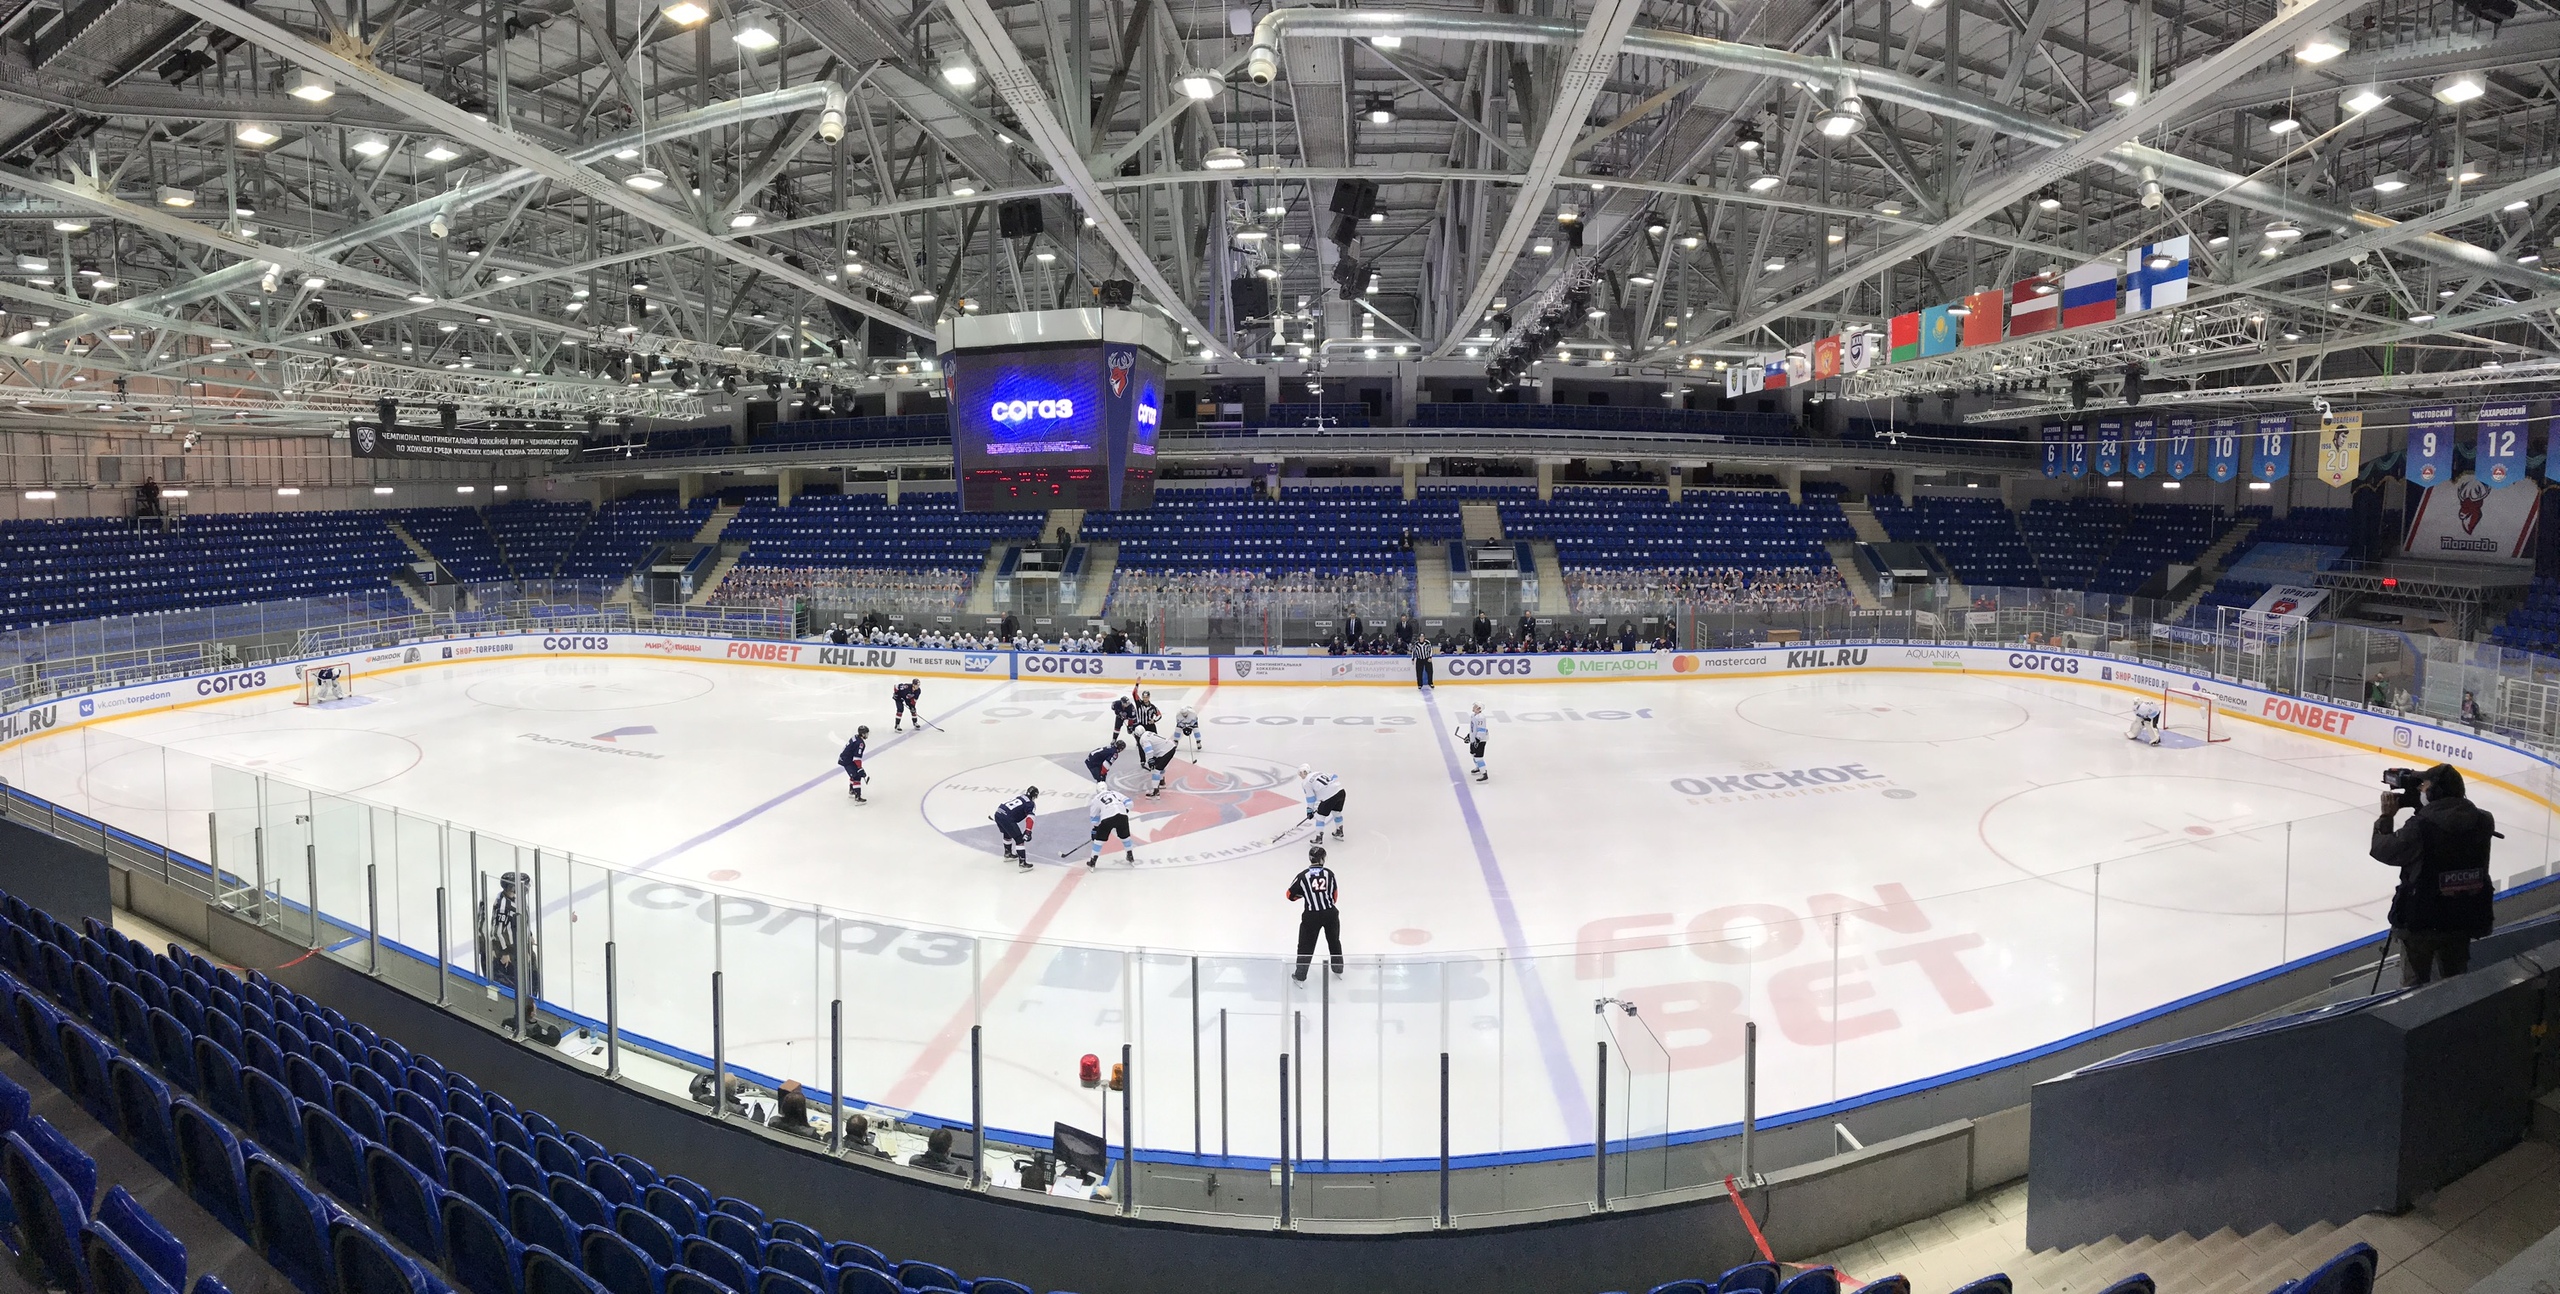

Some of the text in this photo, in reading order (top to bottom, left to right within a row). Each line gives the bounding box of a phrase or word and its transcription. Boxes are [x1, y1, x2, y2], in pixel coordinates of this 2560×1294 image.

[991, 398, 1074, 422] согаз
[2411, 407, 2453, 419] ЧИСТОВСКИЙ
[2480, 405, 2527, 417] САХАРОВСКИЙ
[2331, 416, 2359, 424] ОВАЛЕНКО
[381, 432, 421, 442] ЧЕМПИОНАТ
[421, 434, 479, 445] КОНТИНЕНТАЛЬНОЙ
[2101, 439, 2117, 456] 24
[2137, 436, 2146, 455] 4
[2173, 436, 2189, 455] 17
[2215, 437, 2233, 457] 10
[2262, 435, 2281, 456] 18
[2422, 433, 2437, 457] 9
[2488, 430, 2516, 457] 12
[396, 444, 405, 452] ПО
[2047, 444, 2055, 462] 6
[2071, 443, 2083, 462] 12
[2326, 449, 2348, 471] 20
[2280, 587, 2319, 598] ТОРПЕДО
[543, 637, 609, 651] согаз
[645, 642, 701, 652] МИР ПИЦЦЫ
[726, 642, 802, 662] FONBET
[819, 647, 896, 667] KHL.RU
[945, 658, 961, 666] RUN
[965, 657, 990, 669] SAP
[1705, 656, 1767, 667] mastercard
[1786, 649, 1868, 669] KHL.RU
[1905, 649, 1961, 659] AQUANIKA
[1025, 656, 1104, 674] согаз
[1135, 659, 1182, 671] ГАЗ
[1448, 658, 1531, 676] согаз
[2008, 653, 2079, 674] согаз
[197, 671, 267, 696] согаз
[97, 690, 171, 710] vk.com/torpedonn
[2303, 691, 2325, 702] KHL.RU
[2336, 698, 2359, 709] KHL.RU
[1455, 708, 1652, 724] Haier
[2262, 697, 2355, 735] FONBET
[2371, 706, 2395, 716] KHL.RU
[1210, 715, 1418, 726] согаз
[517, 732, 665, 760] Ростелеком
[2418, 735, 2473, 761] hctorpedo
[1670, 763, 1885, 796] ОКСКОЕ
[1686, 778, 1900, 806] БЕЗАЛКОГОЛЬНОЕ
[1311, 877, 1327, 890] 42
[2445, 871, 2480, 882] РОССИЯ
[498, 914, 506, 922] 78
[627, 882, 975, 967] согаз
[1574, 882, 1932, 982] FON
[1617, 932, 1995, 1075] BET
